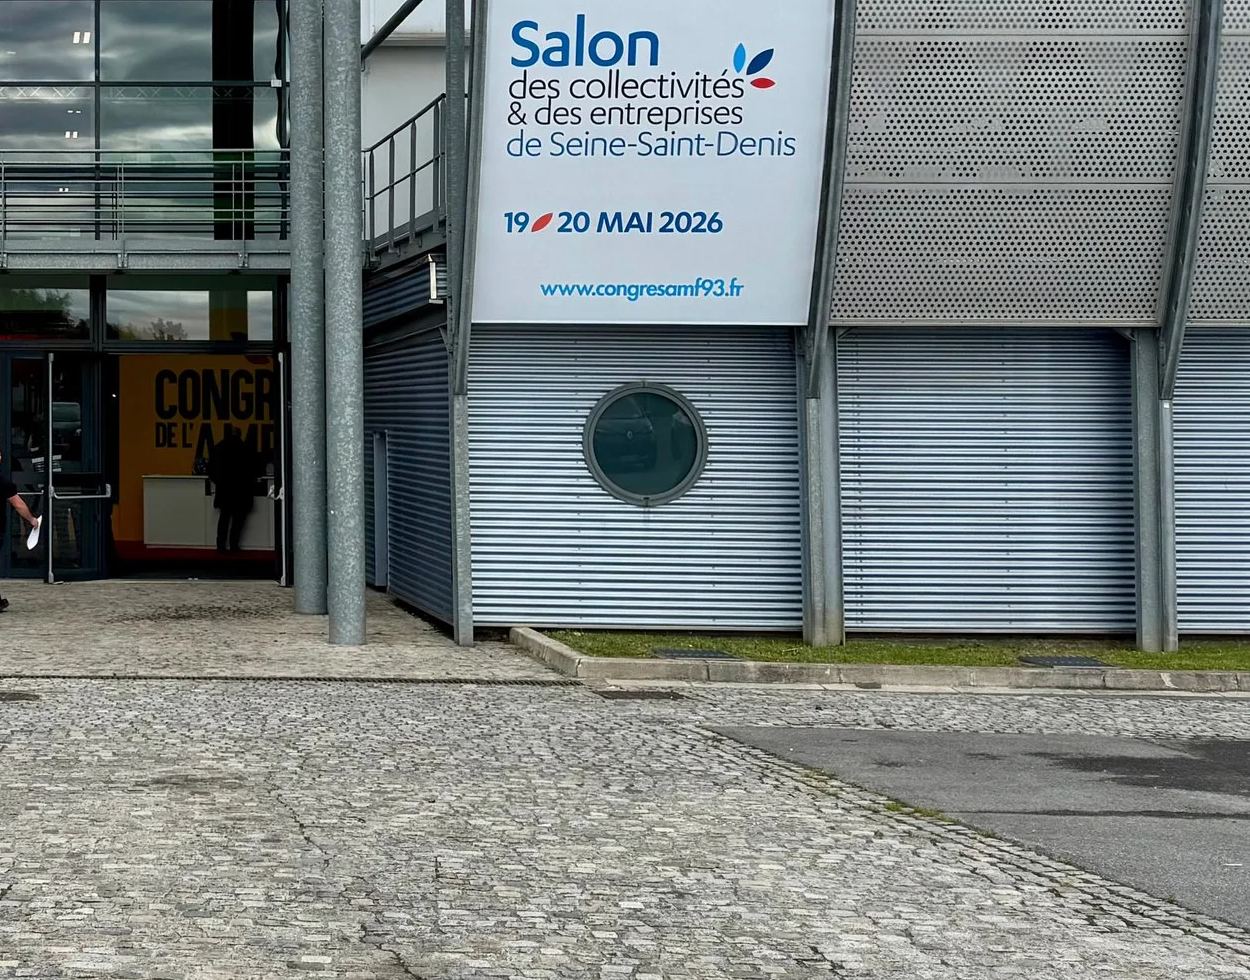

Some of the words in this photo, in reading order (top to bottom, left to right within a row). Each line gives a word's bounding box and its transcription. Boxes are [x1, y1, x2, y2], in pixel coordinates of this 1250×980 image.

[511, 14, 659, 67] Salon
[509, 69, 560, 100] des
[570, 68, 744, 99] collectivités
[508, 101, 527, 126] &
[534, 99, 581, 126] des
[589, 100, 742, 132] entreprises
[507, 129, 541, 157] de
[550, 130, 796, 156] Seine-Saint-Denis
[504, 212, 530, 233] 19
[557, 211, 590, 233] 20
[596, 212, 652, 233] MAI
[659, 211, 723, 234] 2026
[540, 277, 744, 301] www.congresamf93.fr
[155, 422, 177, 448] DE
